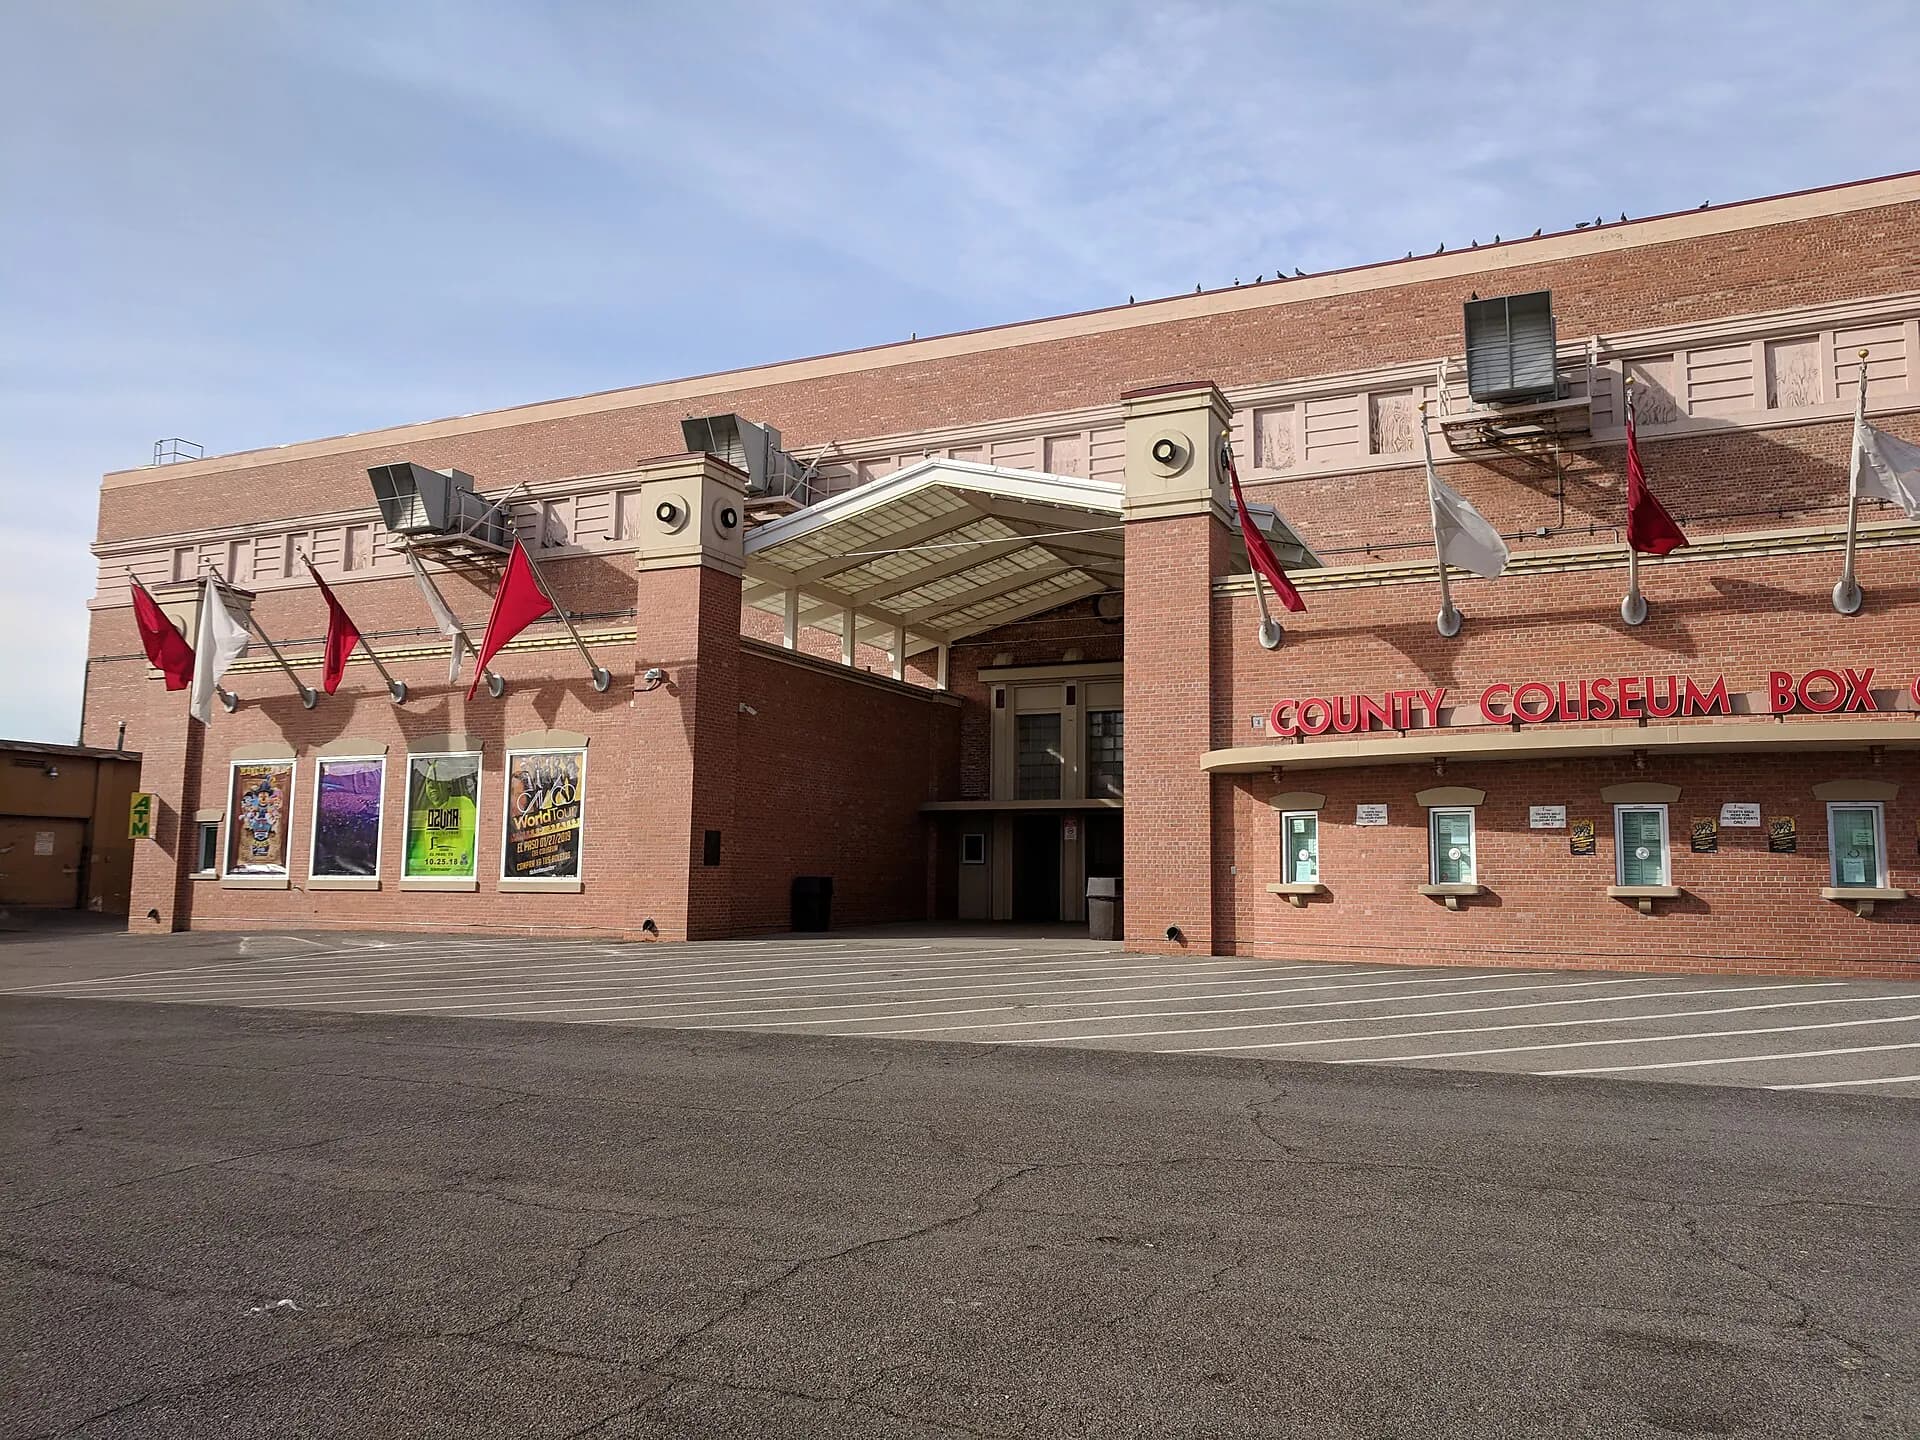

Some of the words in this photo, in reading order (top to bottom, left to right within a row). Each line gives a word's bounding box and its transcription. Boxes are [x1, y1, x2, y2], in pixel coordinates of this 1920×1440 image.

[1270, 687, 1447, 737] COUNTY
[1479, 673, 1733, 724] COLISEUM
[1768, 667, 1879, 714] BOX
[132, 796, 150, 836] ATM
[513, 809, 551, 830] World
[550, 805, 578, 821] Tour
